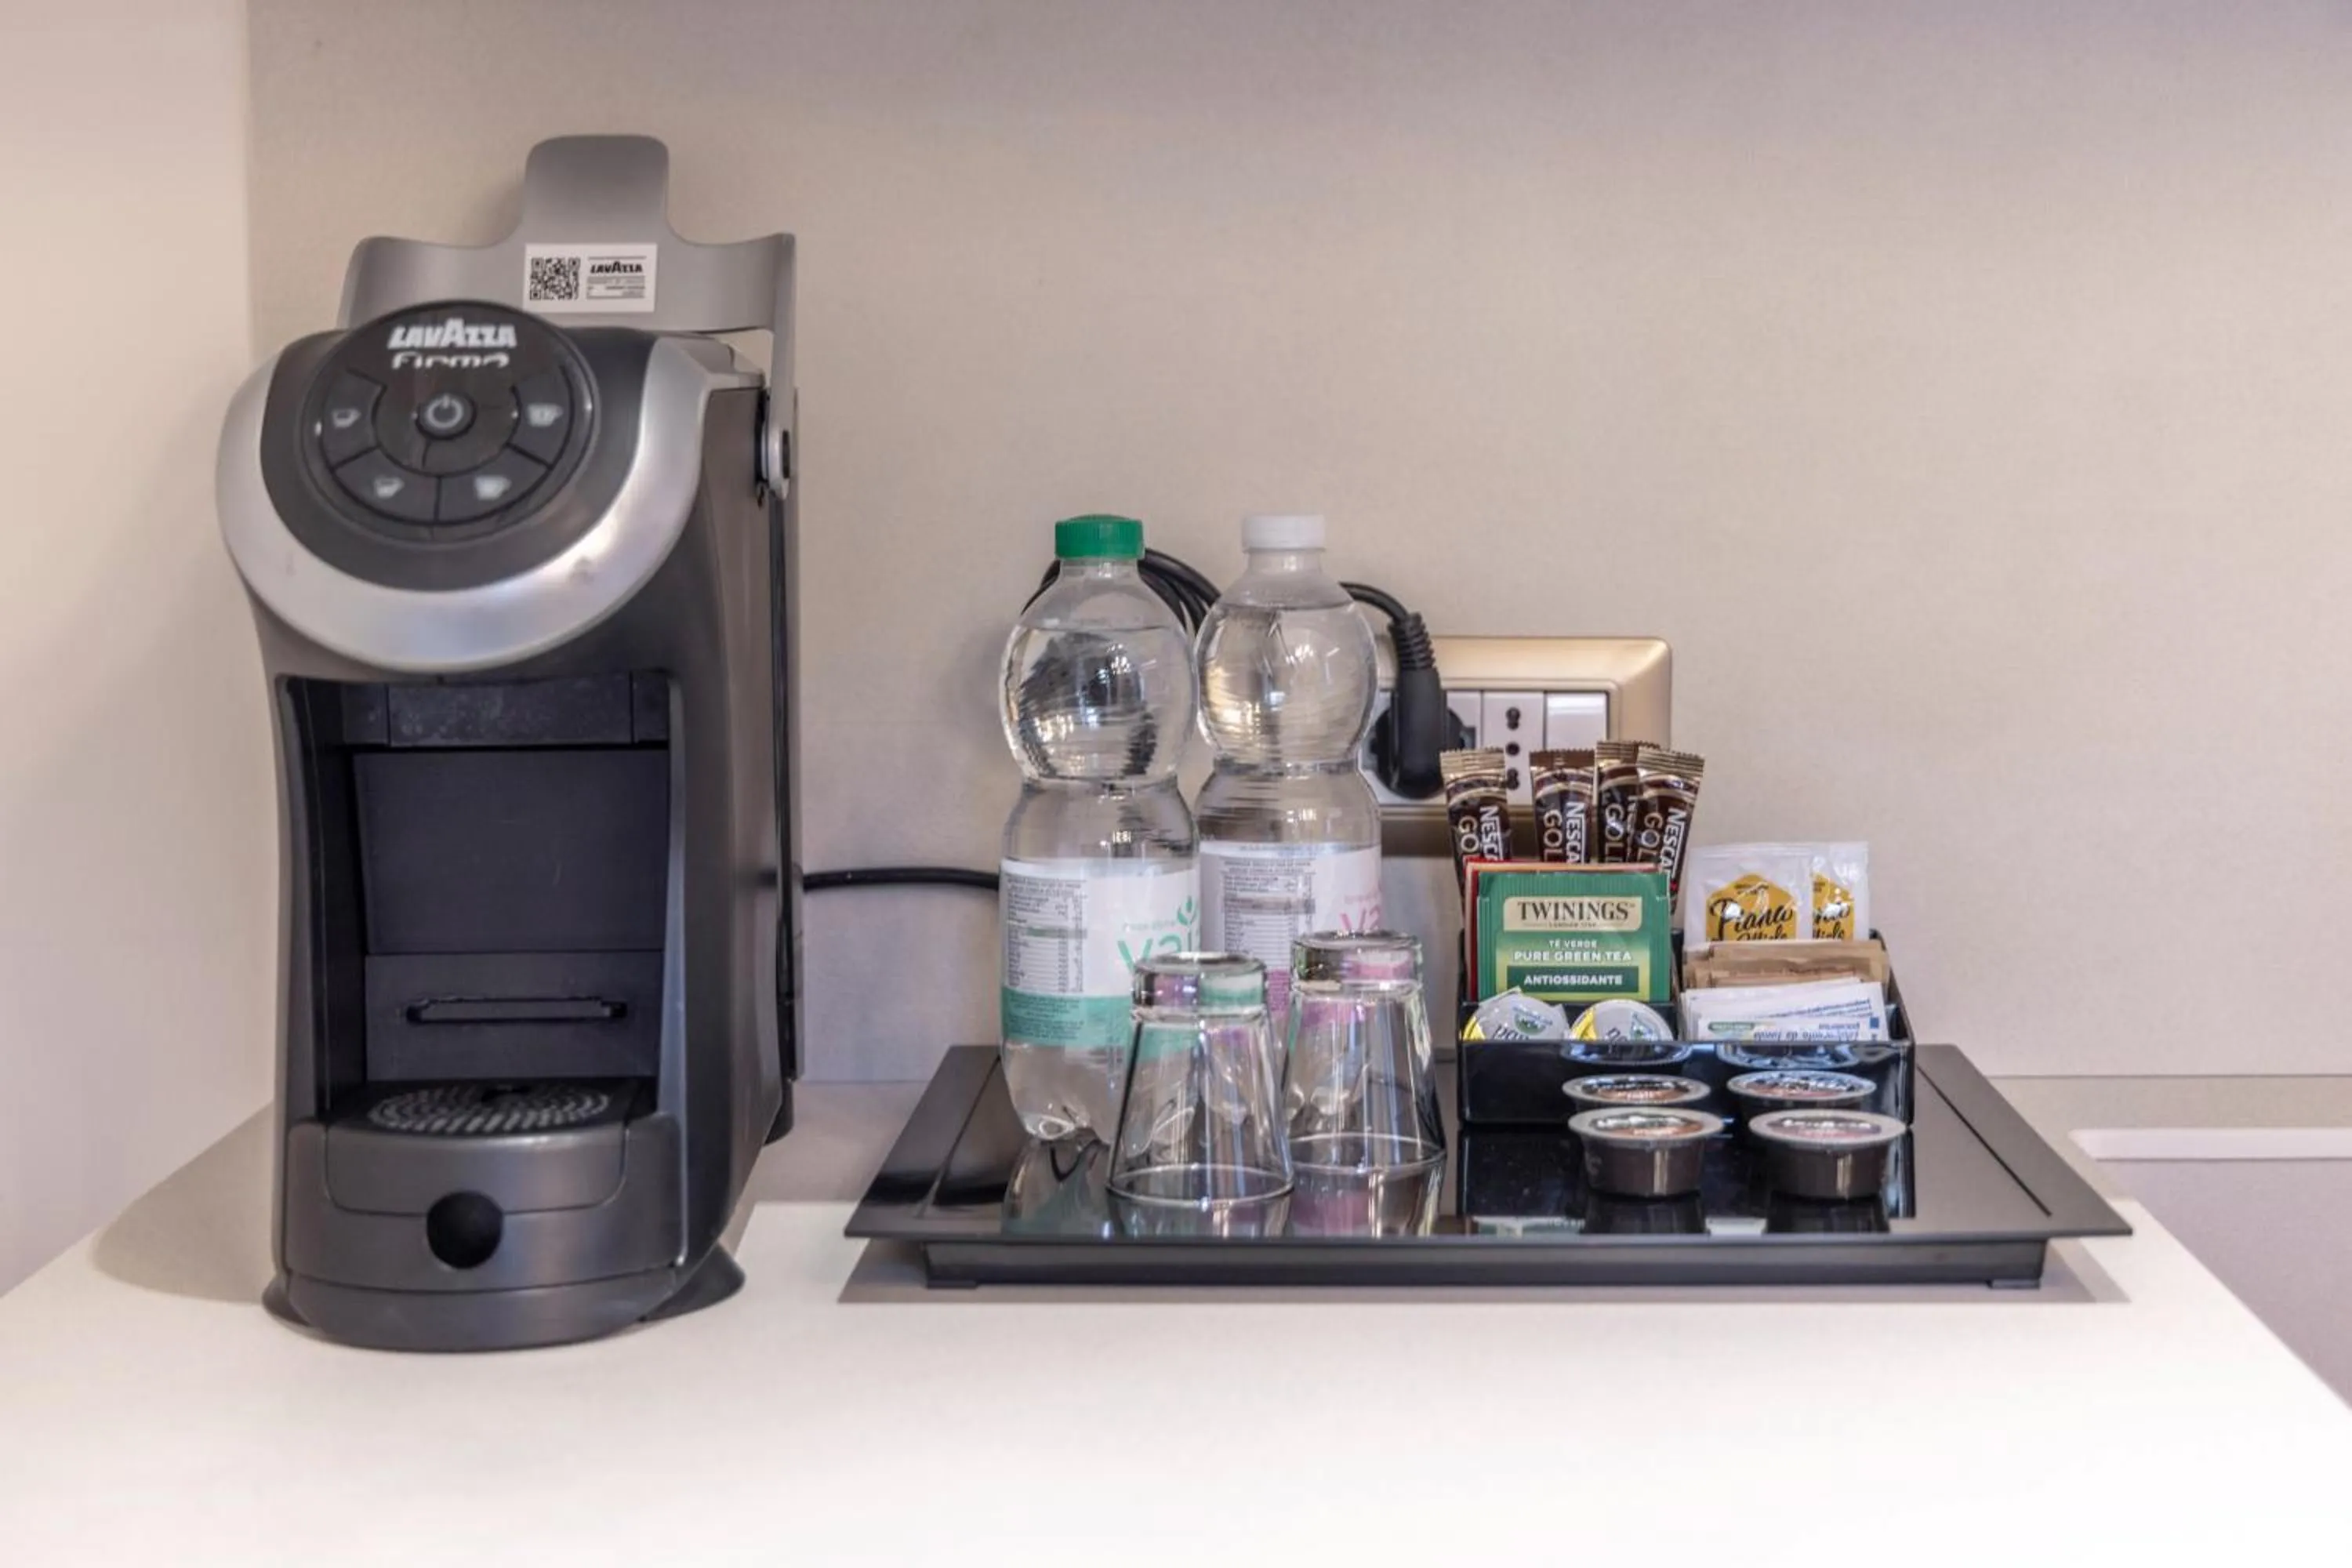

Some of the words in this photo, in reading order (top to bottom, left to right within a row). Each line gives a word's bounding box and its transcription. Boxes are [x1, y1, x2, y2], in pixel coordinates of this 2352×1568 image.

[590, 260, 643, 274] LAVAZZA
[387, 318, 517, 349] LAVAZZA
[1458, 815, 1479, 852] GO
[1480, 804, 1504, 861] NESC
[1543, 809, 1563, 862] GOL
[1566, 800, 1586, 863] NESCA
[1637, 811, 1664, 862] GOL
[1660, 807, 1687, 877] NESCA
[1518, 902, 1629, 921] TWININGS
[1514, 951, 1549, 960] PURE
[1555, 951, 1602, 961] GREEN
[1605, 951, 1632, 960] TEA
[1565, 939, 1598, 949] VERDE
[1523, 975, 1623, 985] ANTIOSSIDANTE
